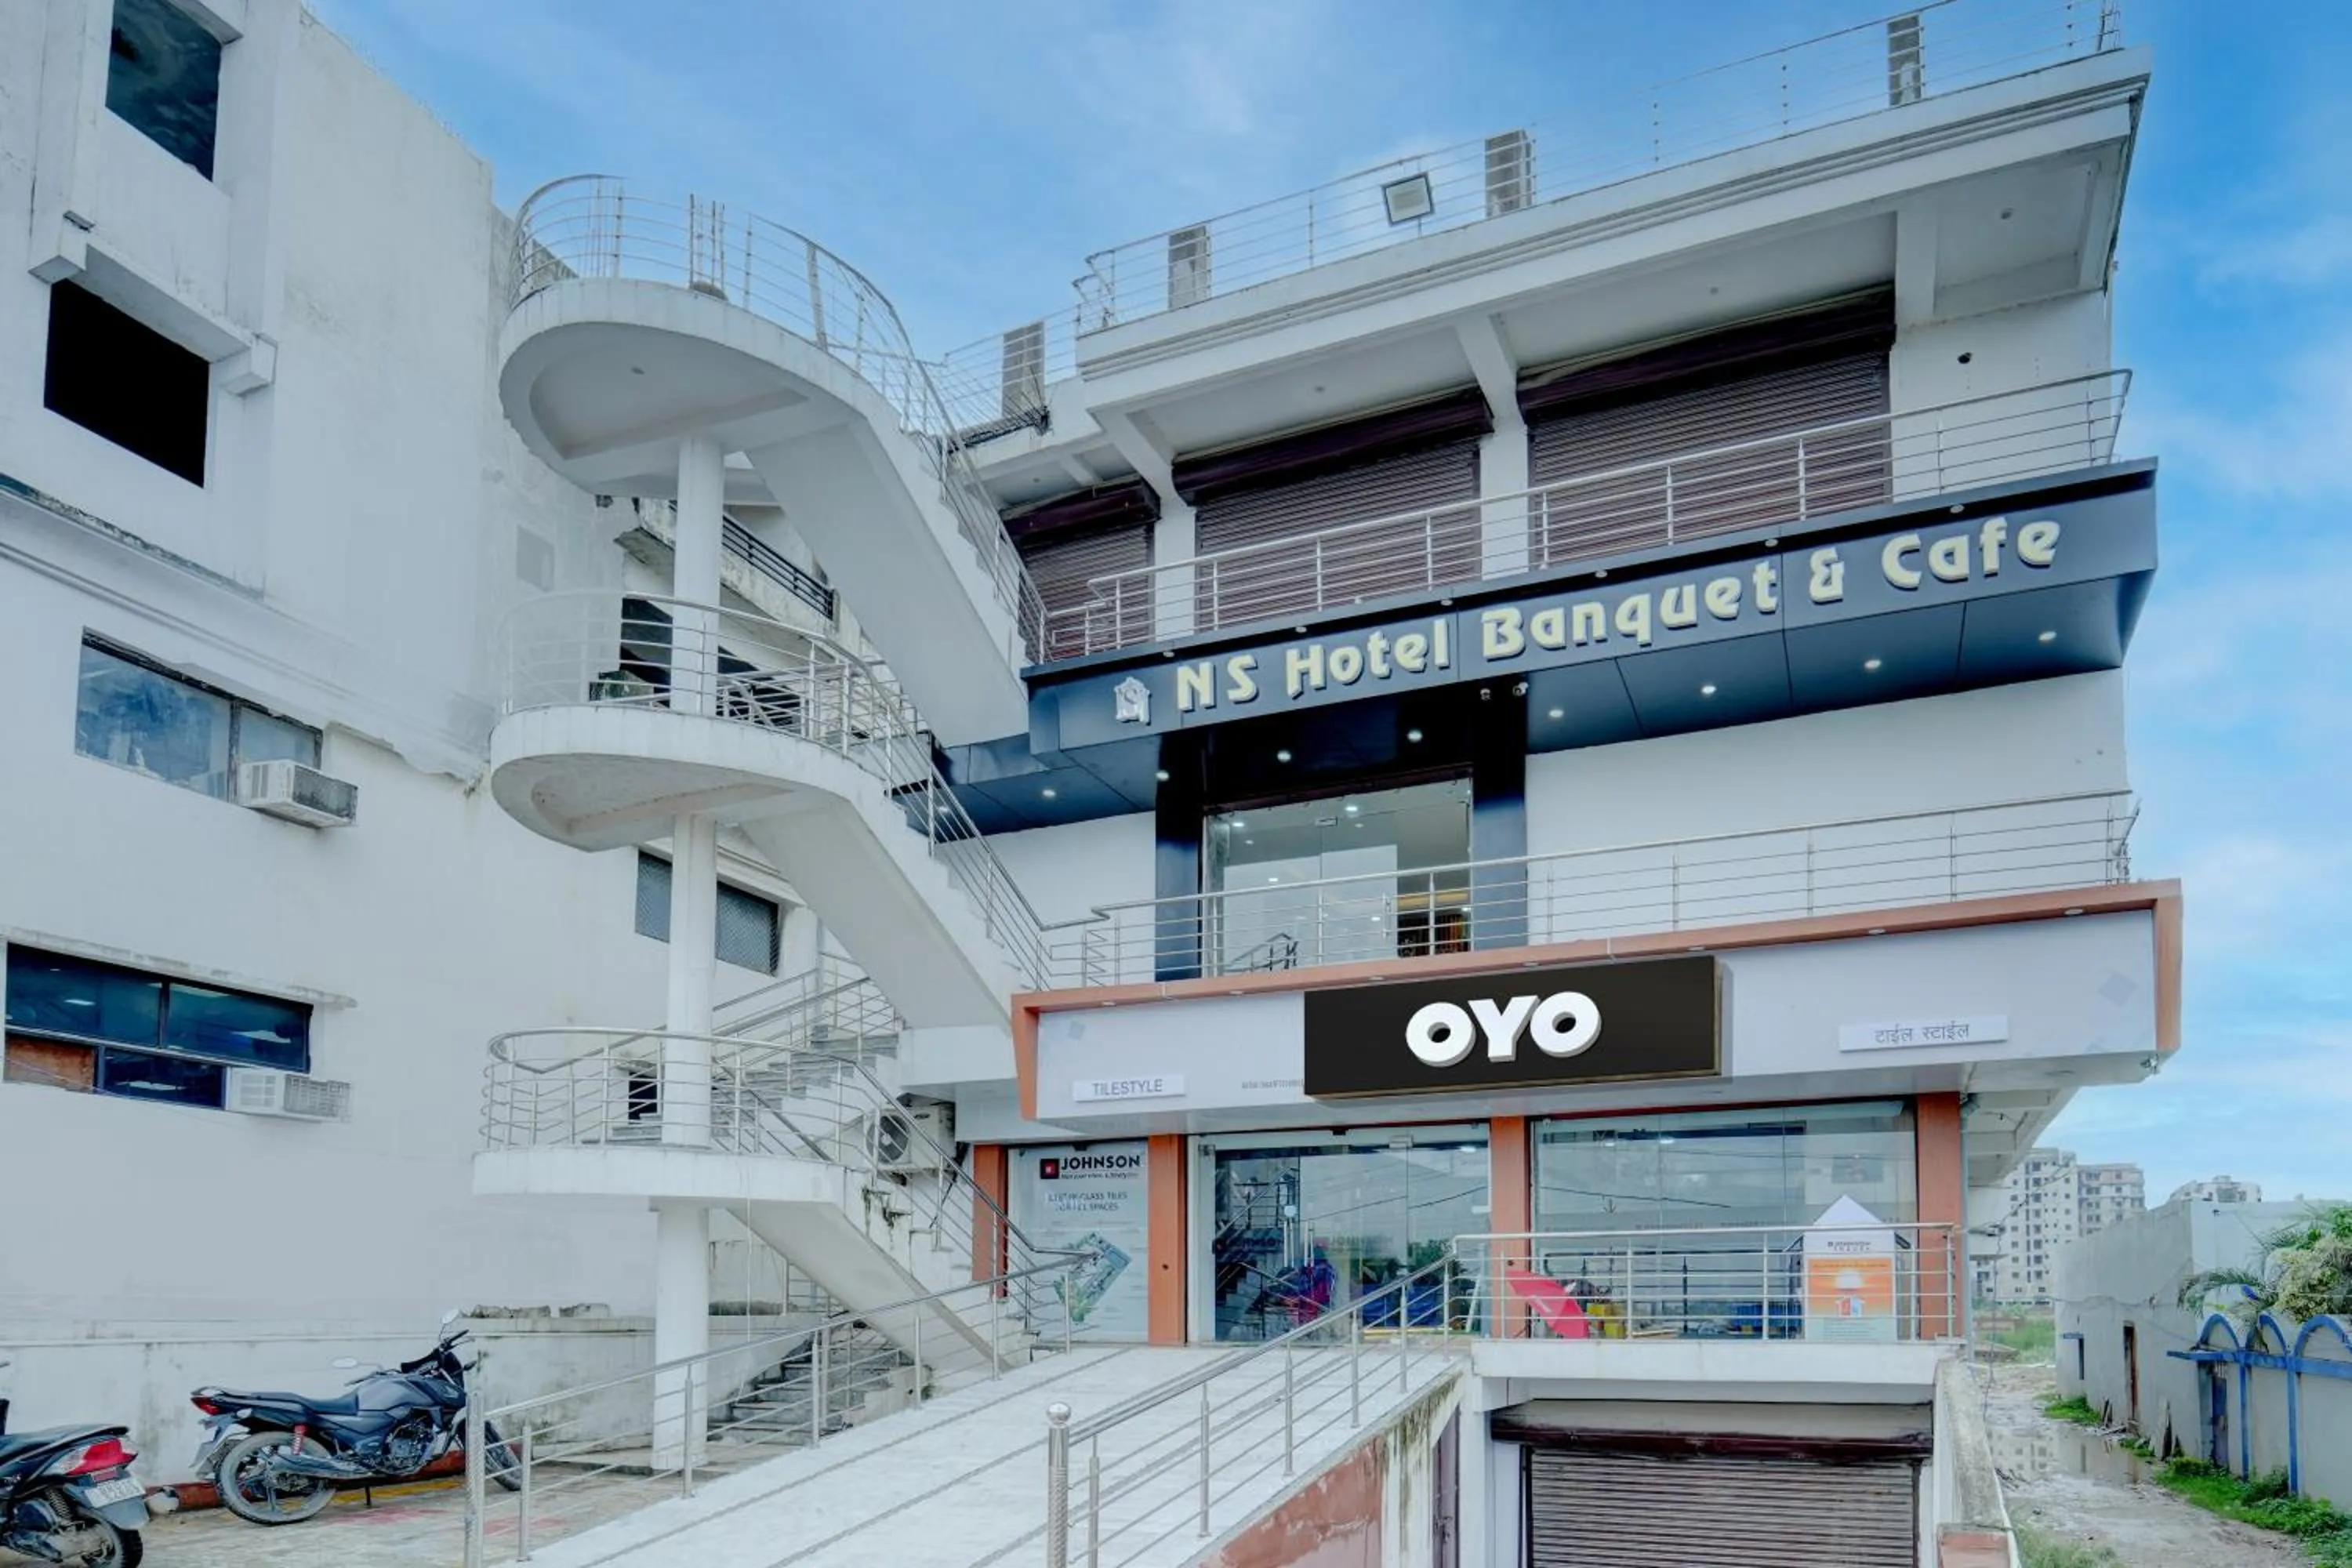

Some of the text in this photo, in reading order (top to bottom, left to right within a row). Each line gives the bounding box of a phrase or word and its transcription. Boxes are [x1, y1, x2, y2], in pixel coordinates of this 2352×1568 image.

[1178, 517, 2061, 711] NS Hotel Banquet & Cafe
[1406, 991, 1602, 1067] OYO
[1091, 1078, 1163, 1096] TILESTYLE
[1061, 1155, 1141, 1171] JOHNSON
